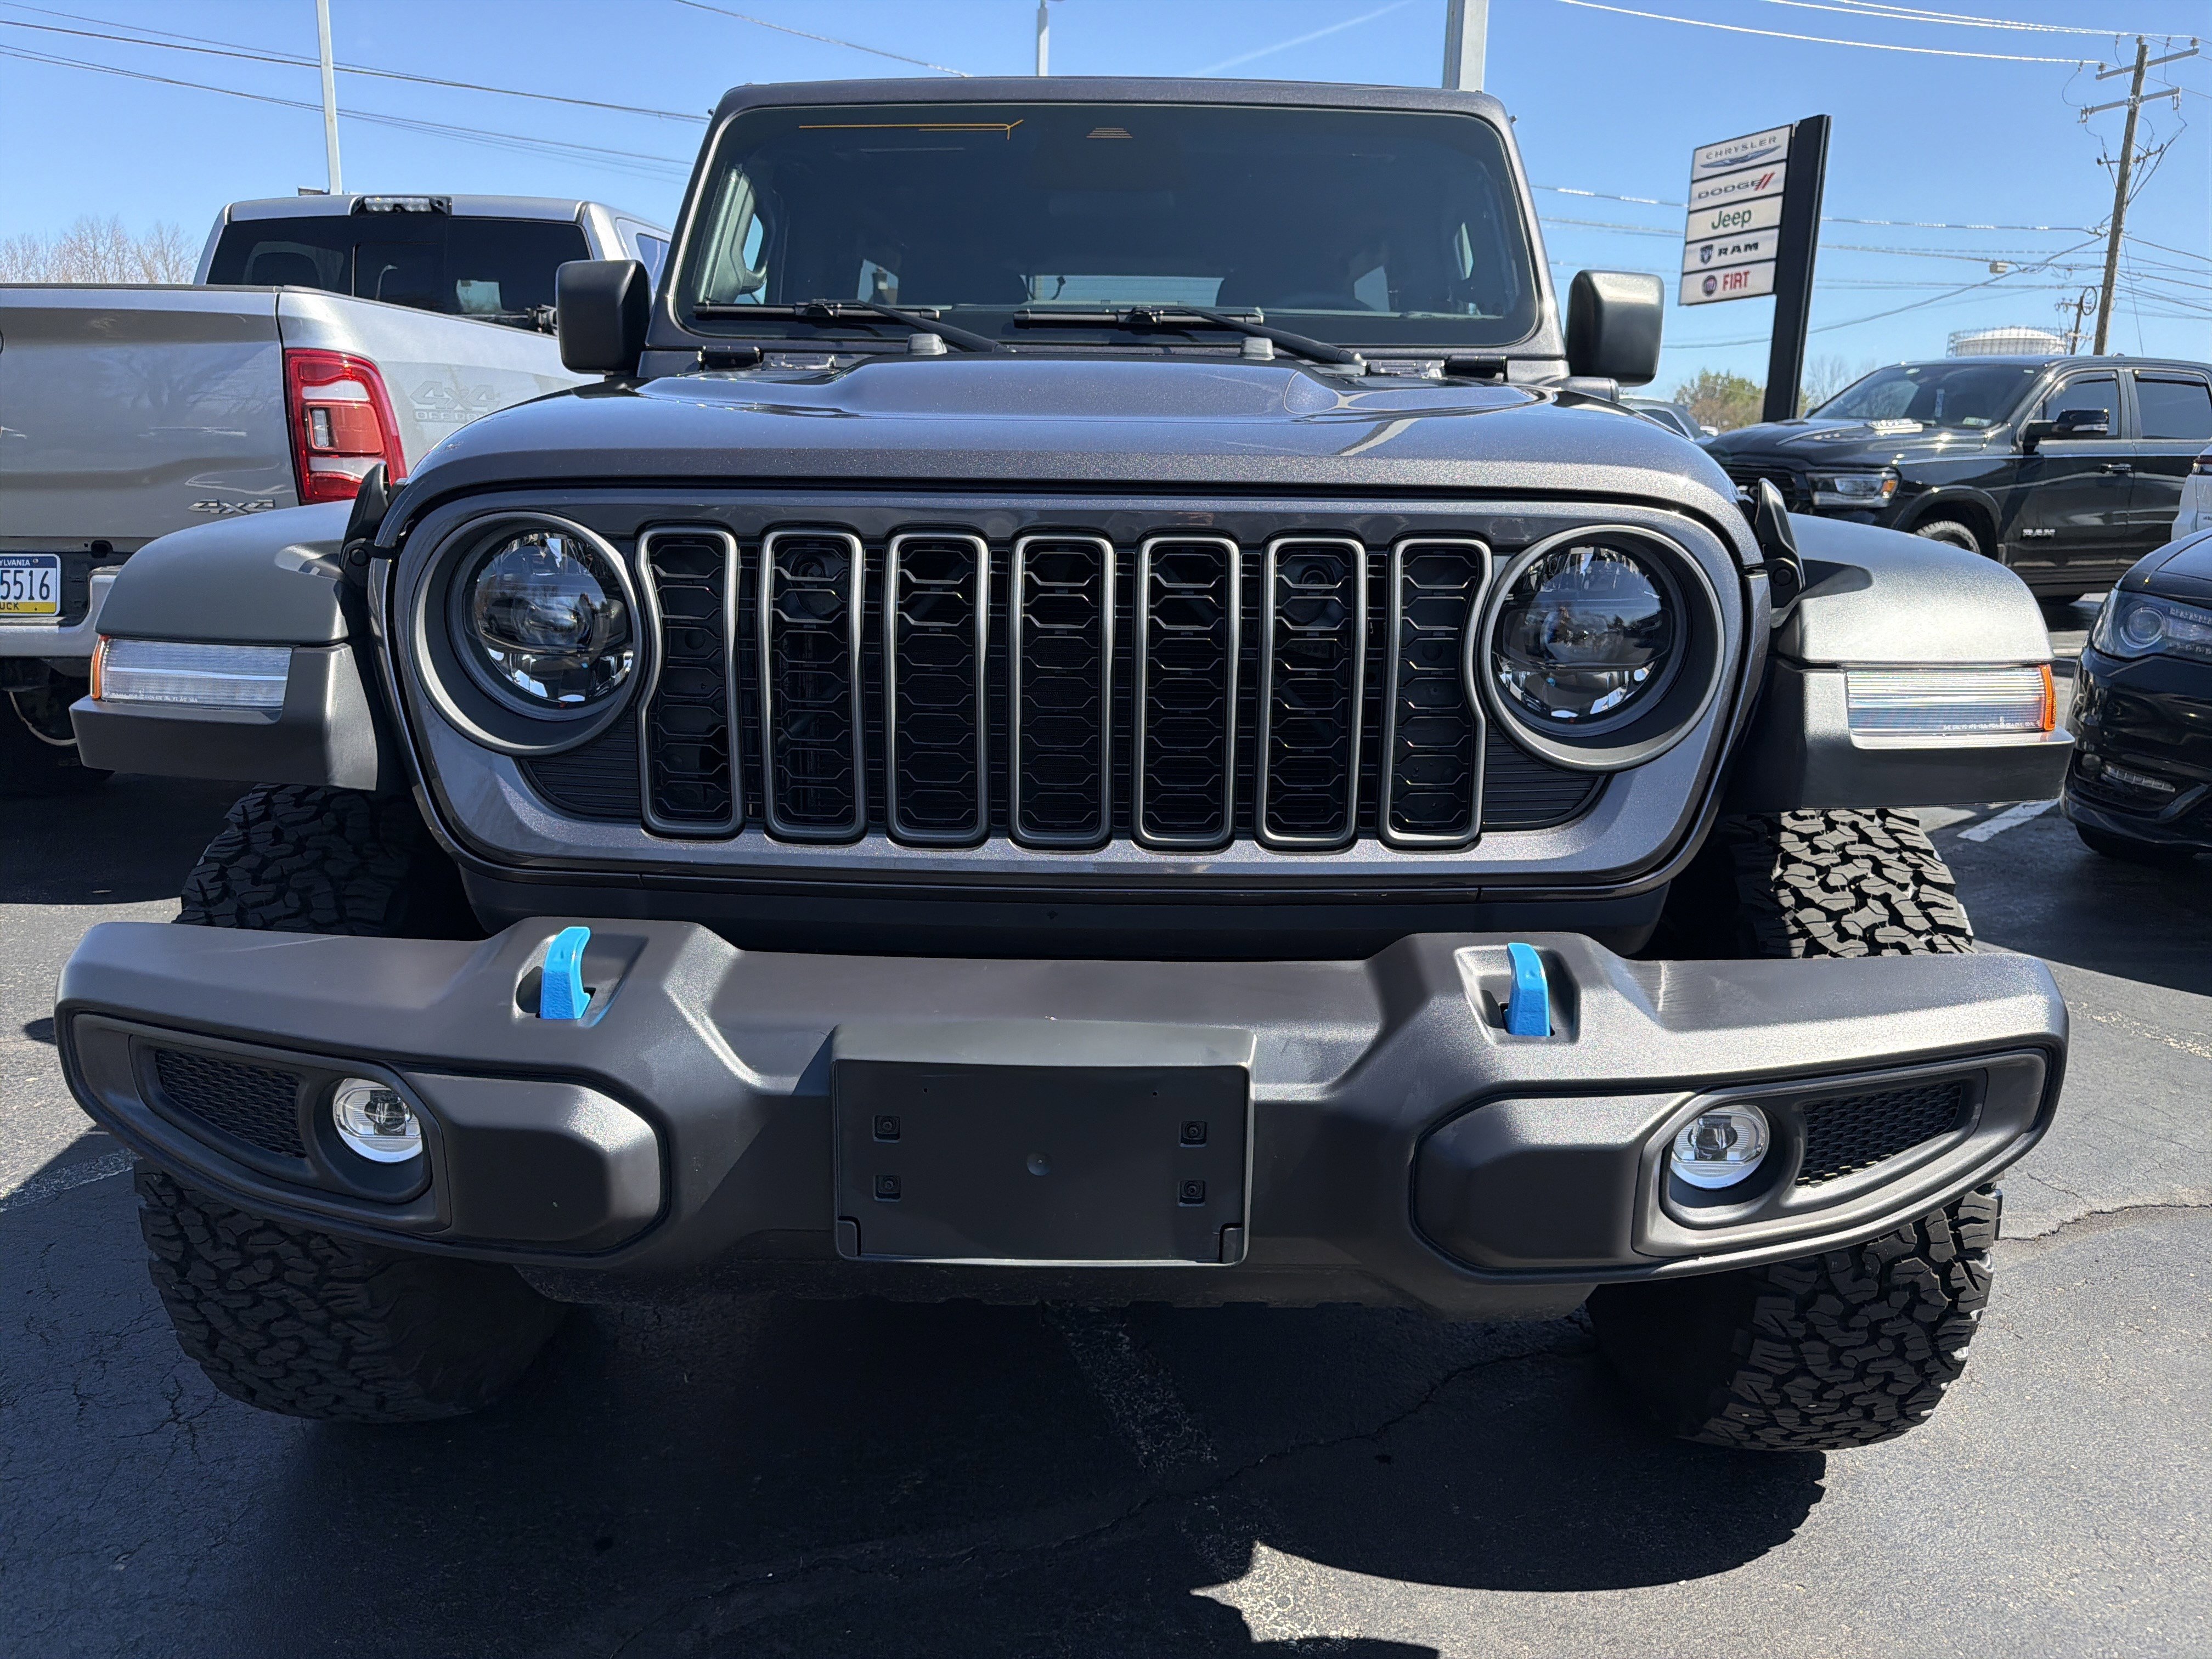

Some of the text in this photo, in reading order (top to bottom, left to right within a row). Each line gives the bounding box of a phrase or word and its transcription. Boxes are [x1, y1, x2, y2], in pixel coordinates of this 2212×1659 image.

[1706, 136, 1777, 160] CHRYSLER
[1697, 178, 1763, 199] DODGE
[1711, 210, 1752, 230] Jeep
[1718, 242, 1759, 257] RAM
[1722, 270, 1751, 291] FIAT
[415, 411, 450, 421] OFF
[0, 569, 50, 600] 5516
